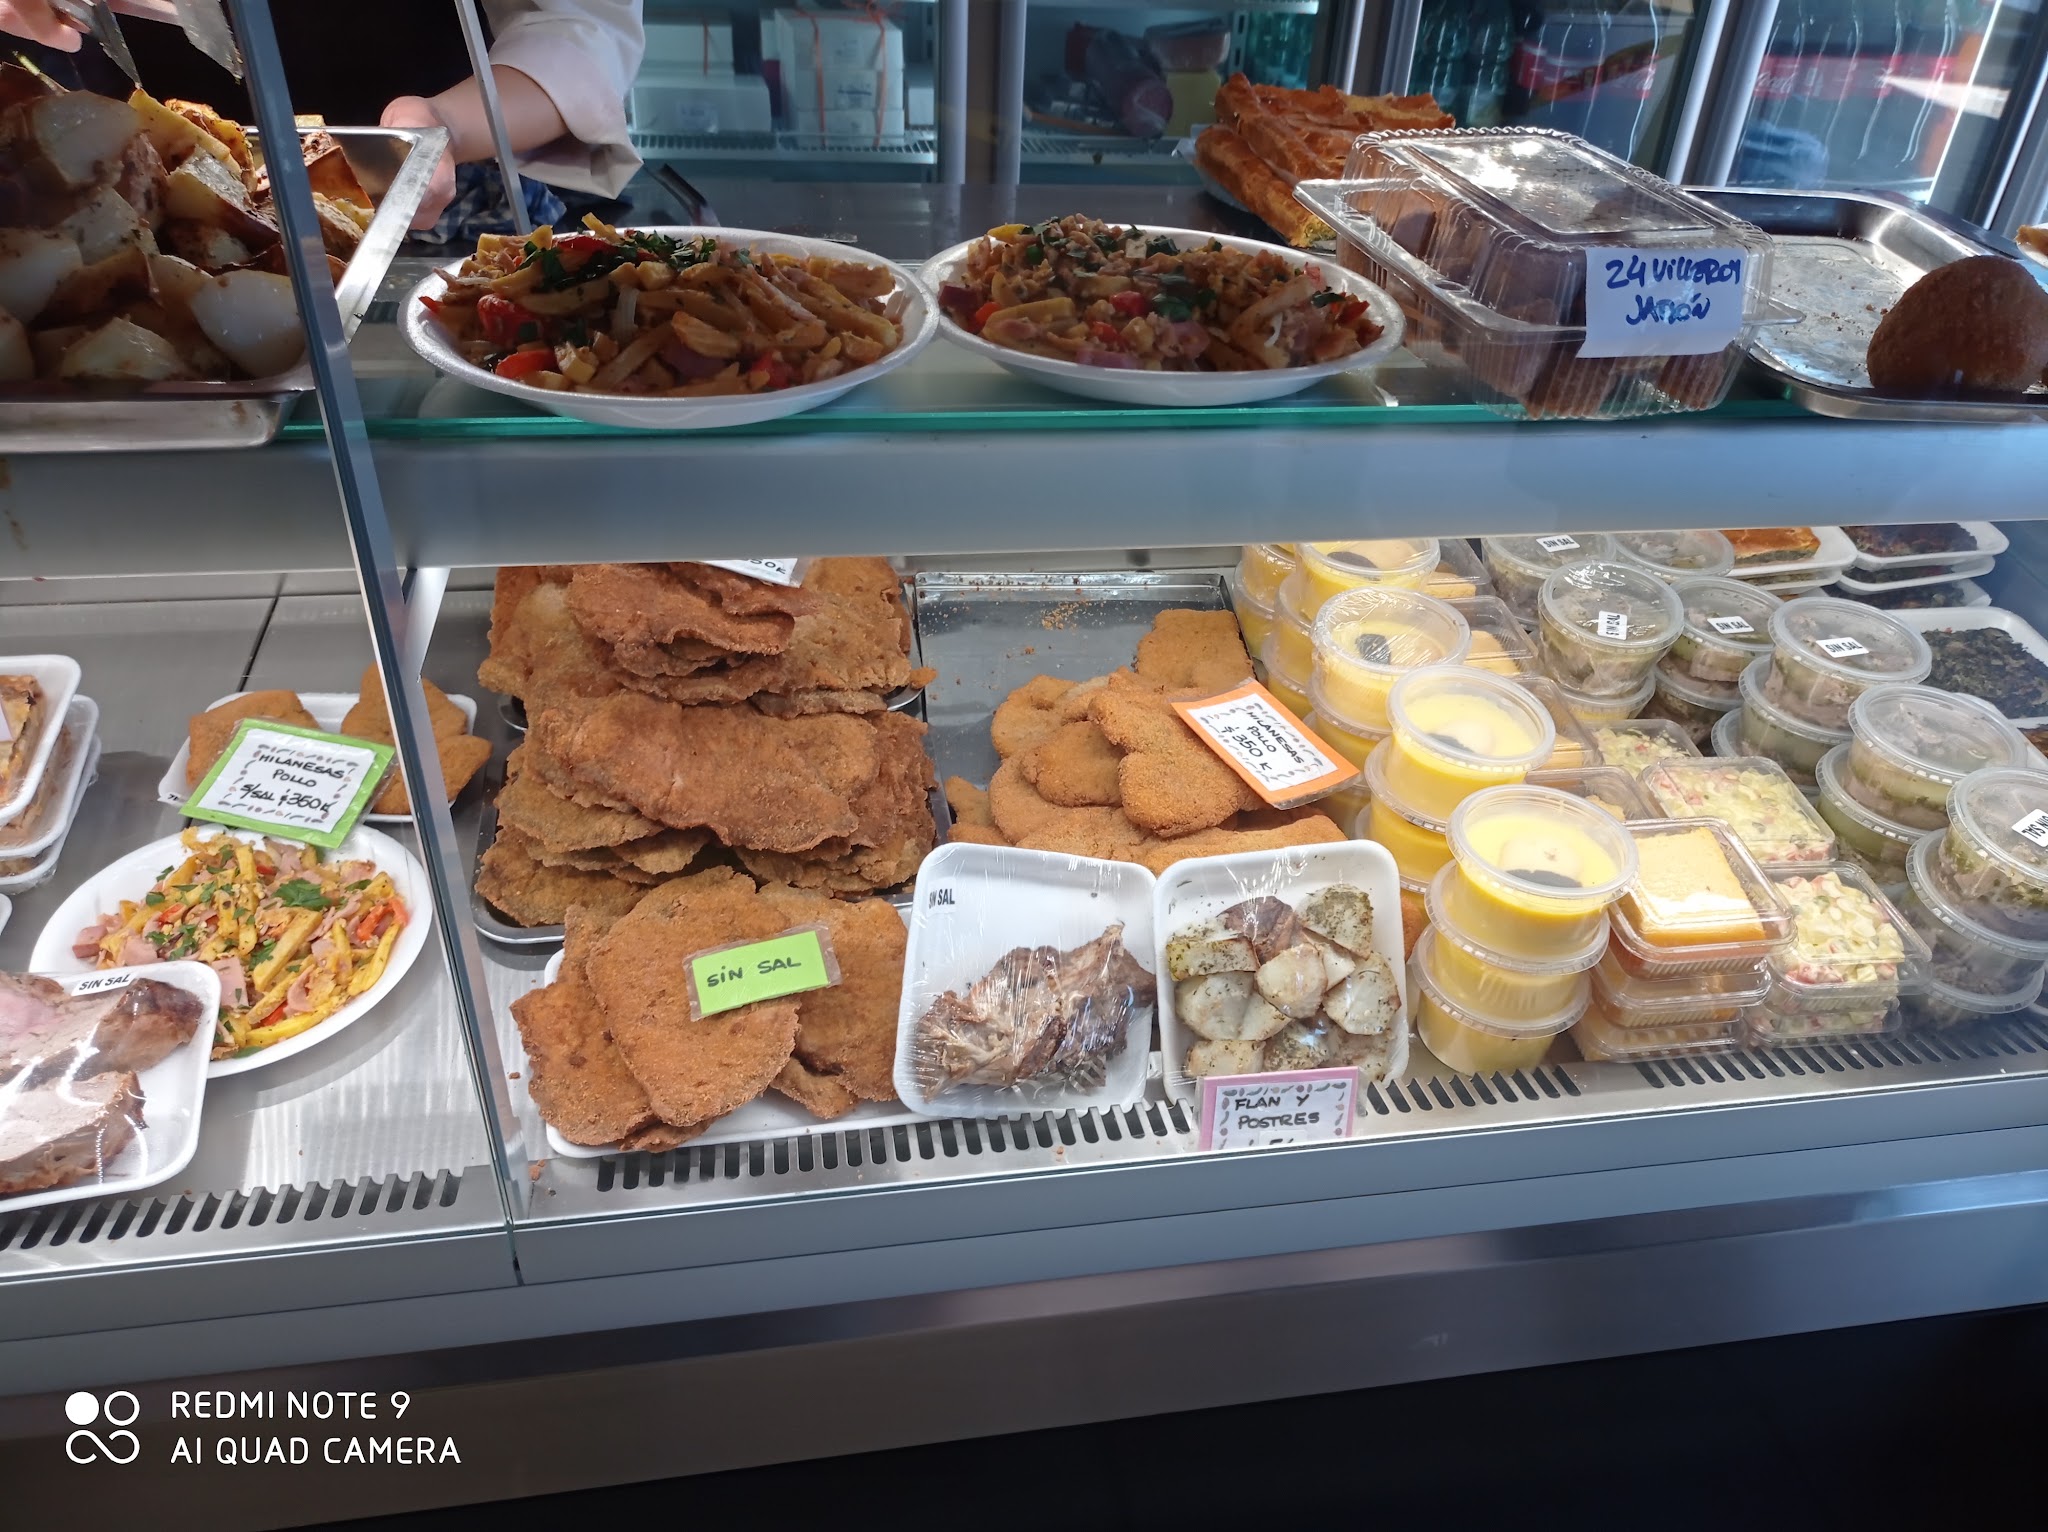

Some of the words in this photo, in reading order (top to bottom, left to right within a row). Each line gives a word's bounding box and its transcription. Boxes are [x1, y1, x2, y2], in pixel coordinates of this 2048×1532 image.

[1605, 254, 1647, 289] 24
[1543, 540, 1559, 548] SIN
[1559, 537, 1575, 546] SAL
[1715, 622, 1733, 631] SIN
[1733, 620, 1751, 629] SAL
[1825, 643, 1844, 653] SIN
[1844, 641, 1863, 651] SAL
[1246, 725, 1278, 753] POLLO
[272, 769, 317, 787] POLLO
[2021, 824, 2046, 840] SAL
[937, 888, 956, 906] SAL
[757, 957, 802, 975] SAL
[79, 979, 104, 991] SIN
[104, 974, 131, 986] SAL
[1235, 1096, 1281, 1111] FLAN
[1295, 1093, 1310, 1107] Y
[1237, 1111, 1320, 1130] POSTRES
